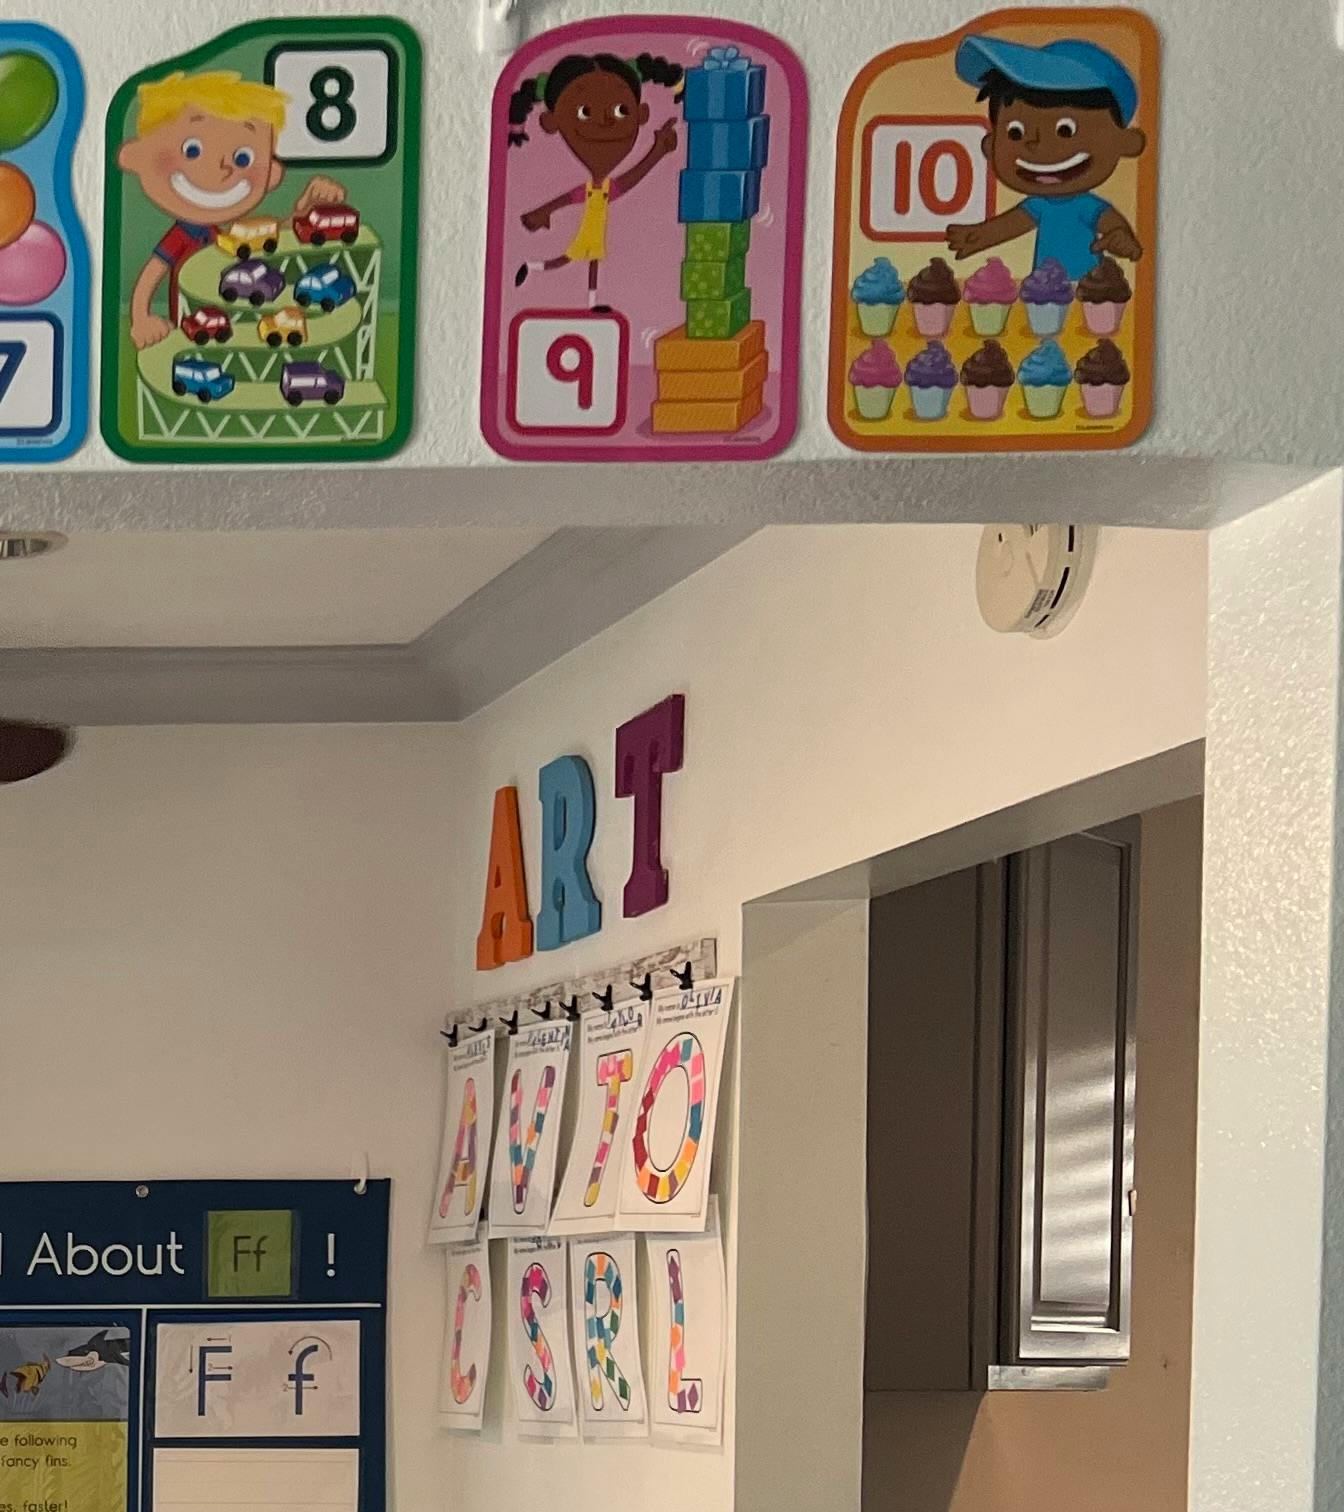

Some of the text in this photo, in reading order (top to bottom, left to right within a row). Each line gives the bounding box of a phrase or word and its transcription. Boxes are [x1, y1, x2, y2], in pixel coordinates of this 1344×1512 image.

[305, 64, 358, 142] 8
[894, 138, 974, 216] 10
[545, 332, 595, 411] 9
[476, 694, 685, 971] ART
[438, 1077, 478, 1219] A
[509, 1065, 557, 1215] V
[584, 1047, 634, 1208] T
[632, 1031, 707, 1204] O
[26, 1231, 185, 1277] About
[232, 1234, 269, 1273] Ff
[325, 1233, 336, 1277] !
[197, 1344, 319, 1417] F f
[450, 1263, 481, 1405] C
[520, 1261, 558, 1412] S
[583, 1251, 632, 1412] R
[665, 1248, 704, 1413] L
[0, 1454, 40, 1471] fancy
[14, 1434, 78, 1450] following
